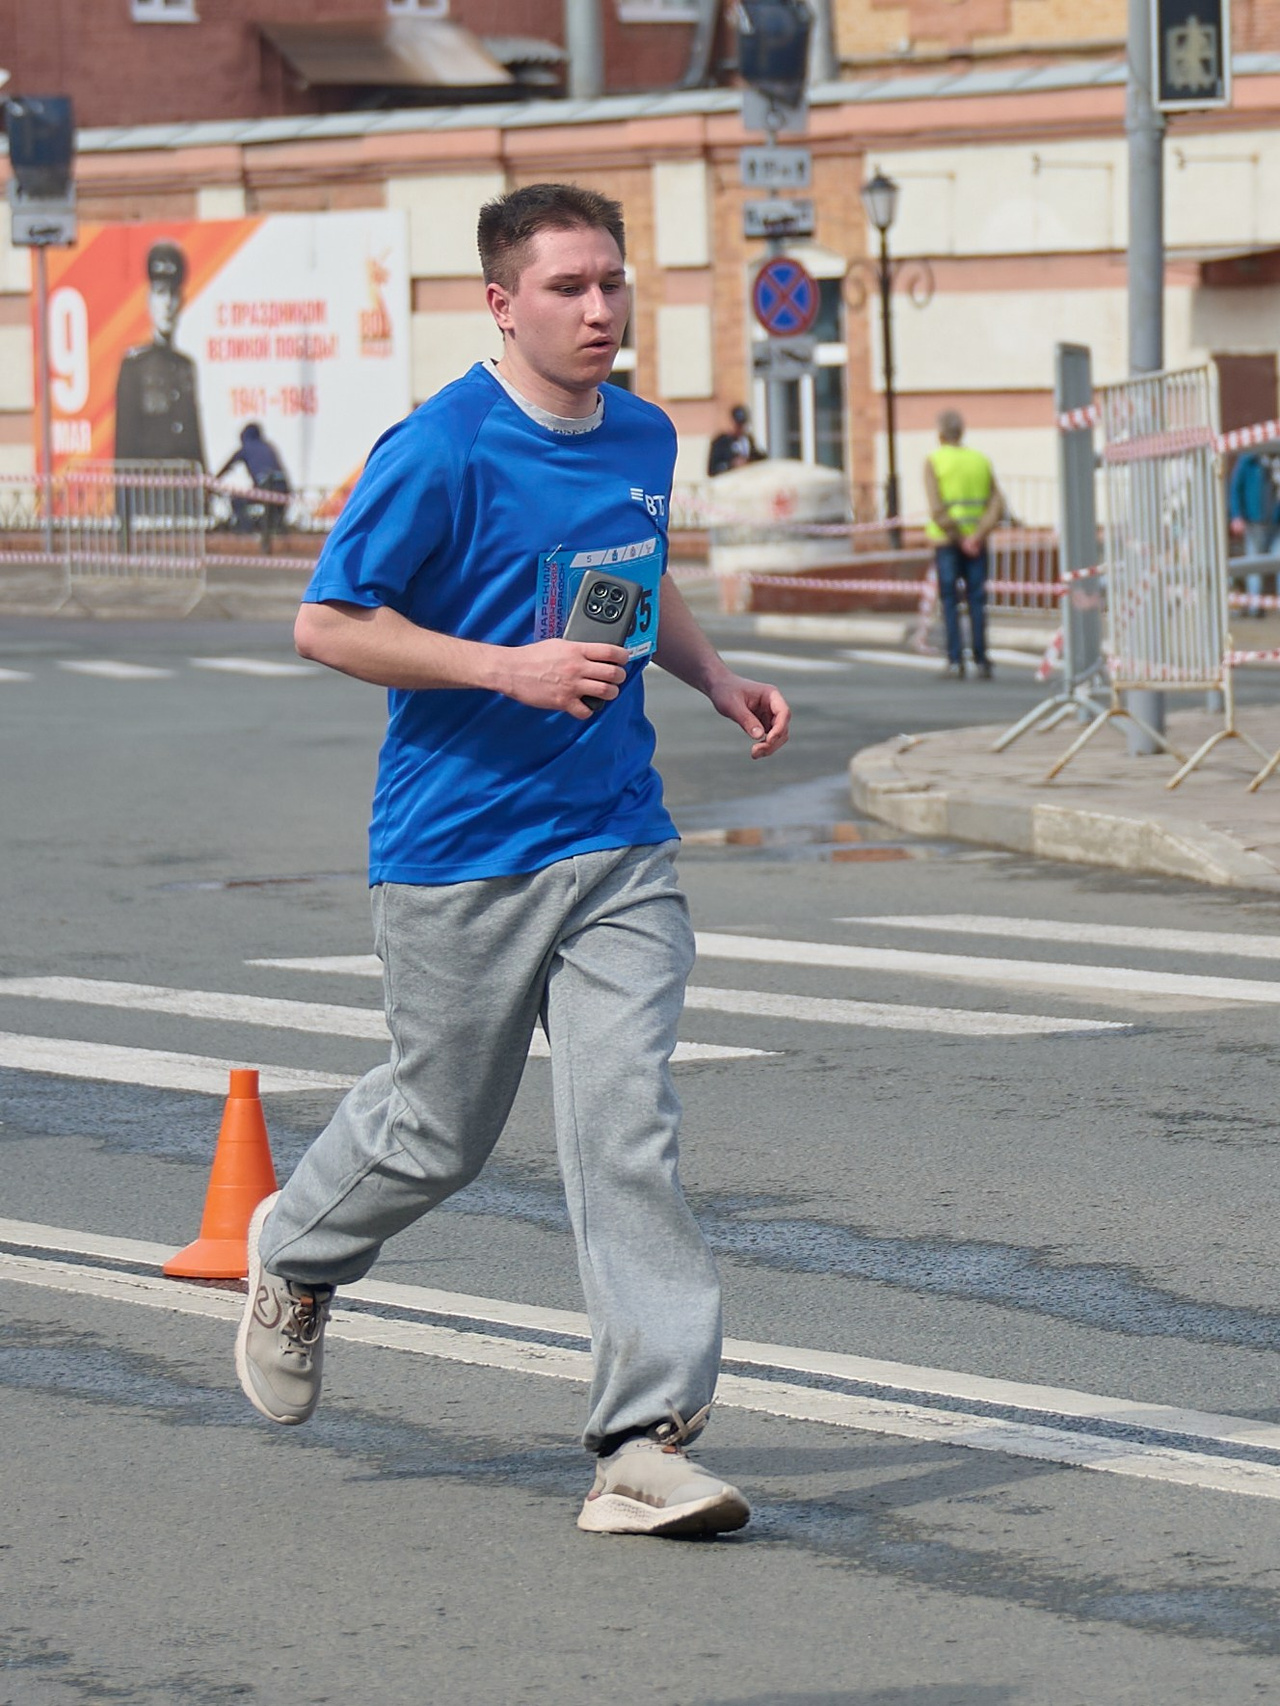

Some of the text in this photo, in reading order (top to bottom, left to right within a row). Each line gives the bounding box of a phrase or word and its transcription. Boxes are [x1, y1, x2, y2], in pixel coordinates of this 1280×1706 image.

[217, 301, 326, 328] С ПРАЗДНИКОМ
[49, 287, 90, 414] 9
[207, 334, 270, 361] ВЕЛИКОЙ
[275, 334, 337, 361] ПОБЕДЫ!
[51, 420, 91, 453] МАЯ
[540, 561, 551, 639] МАРСКИЙ
